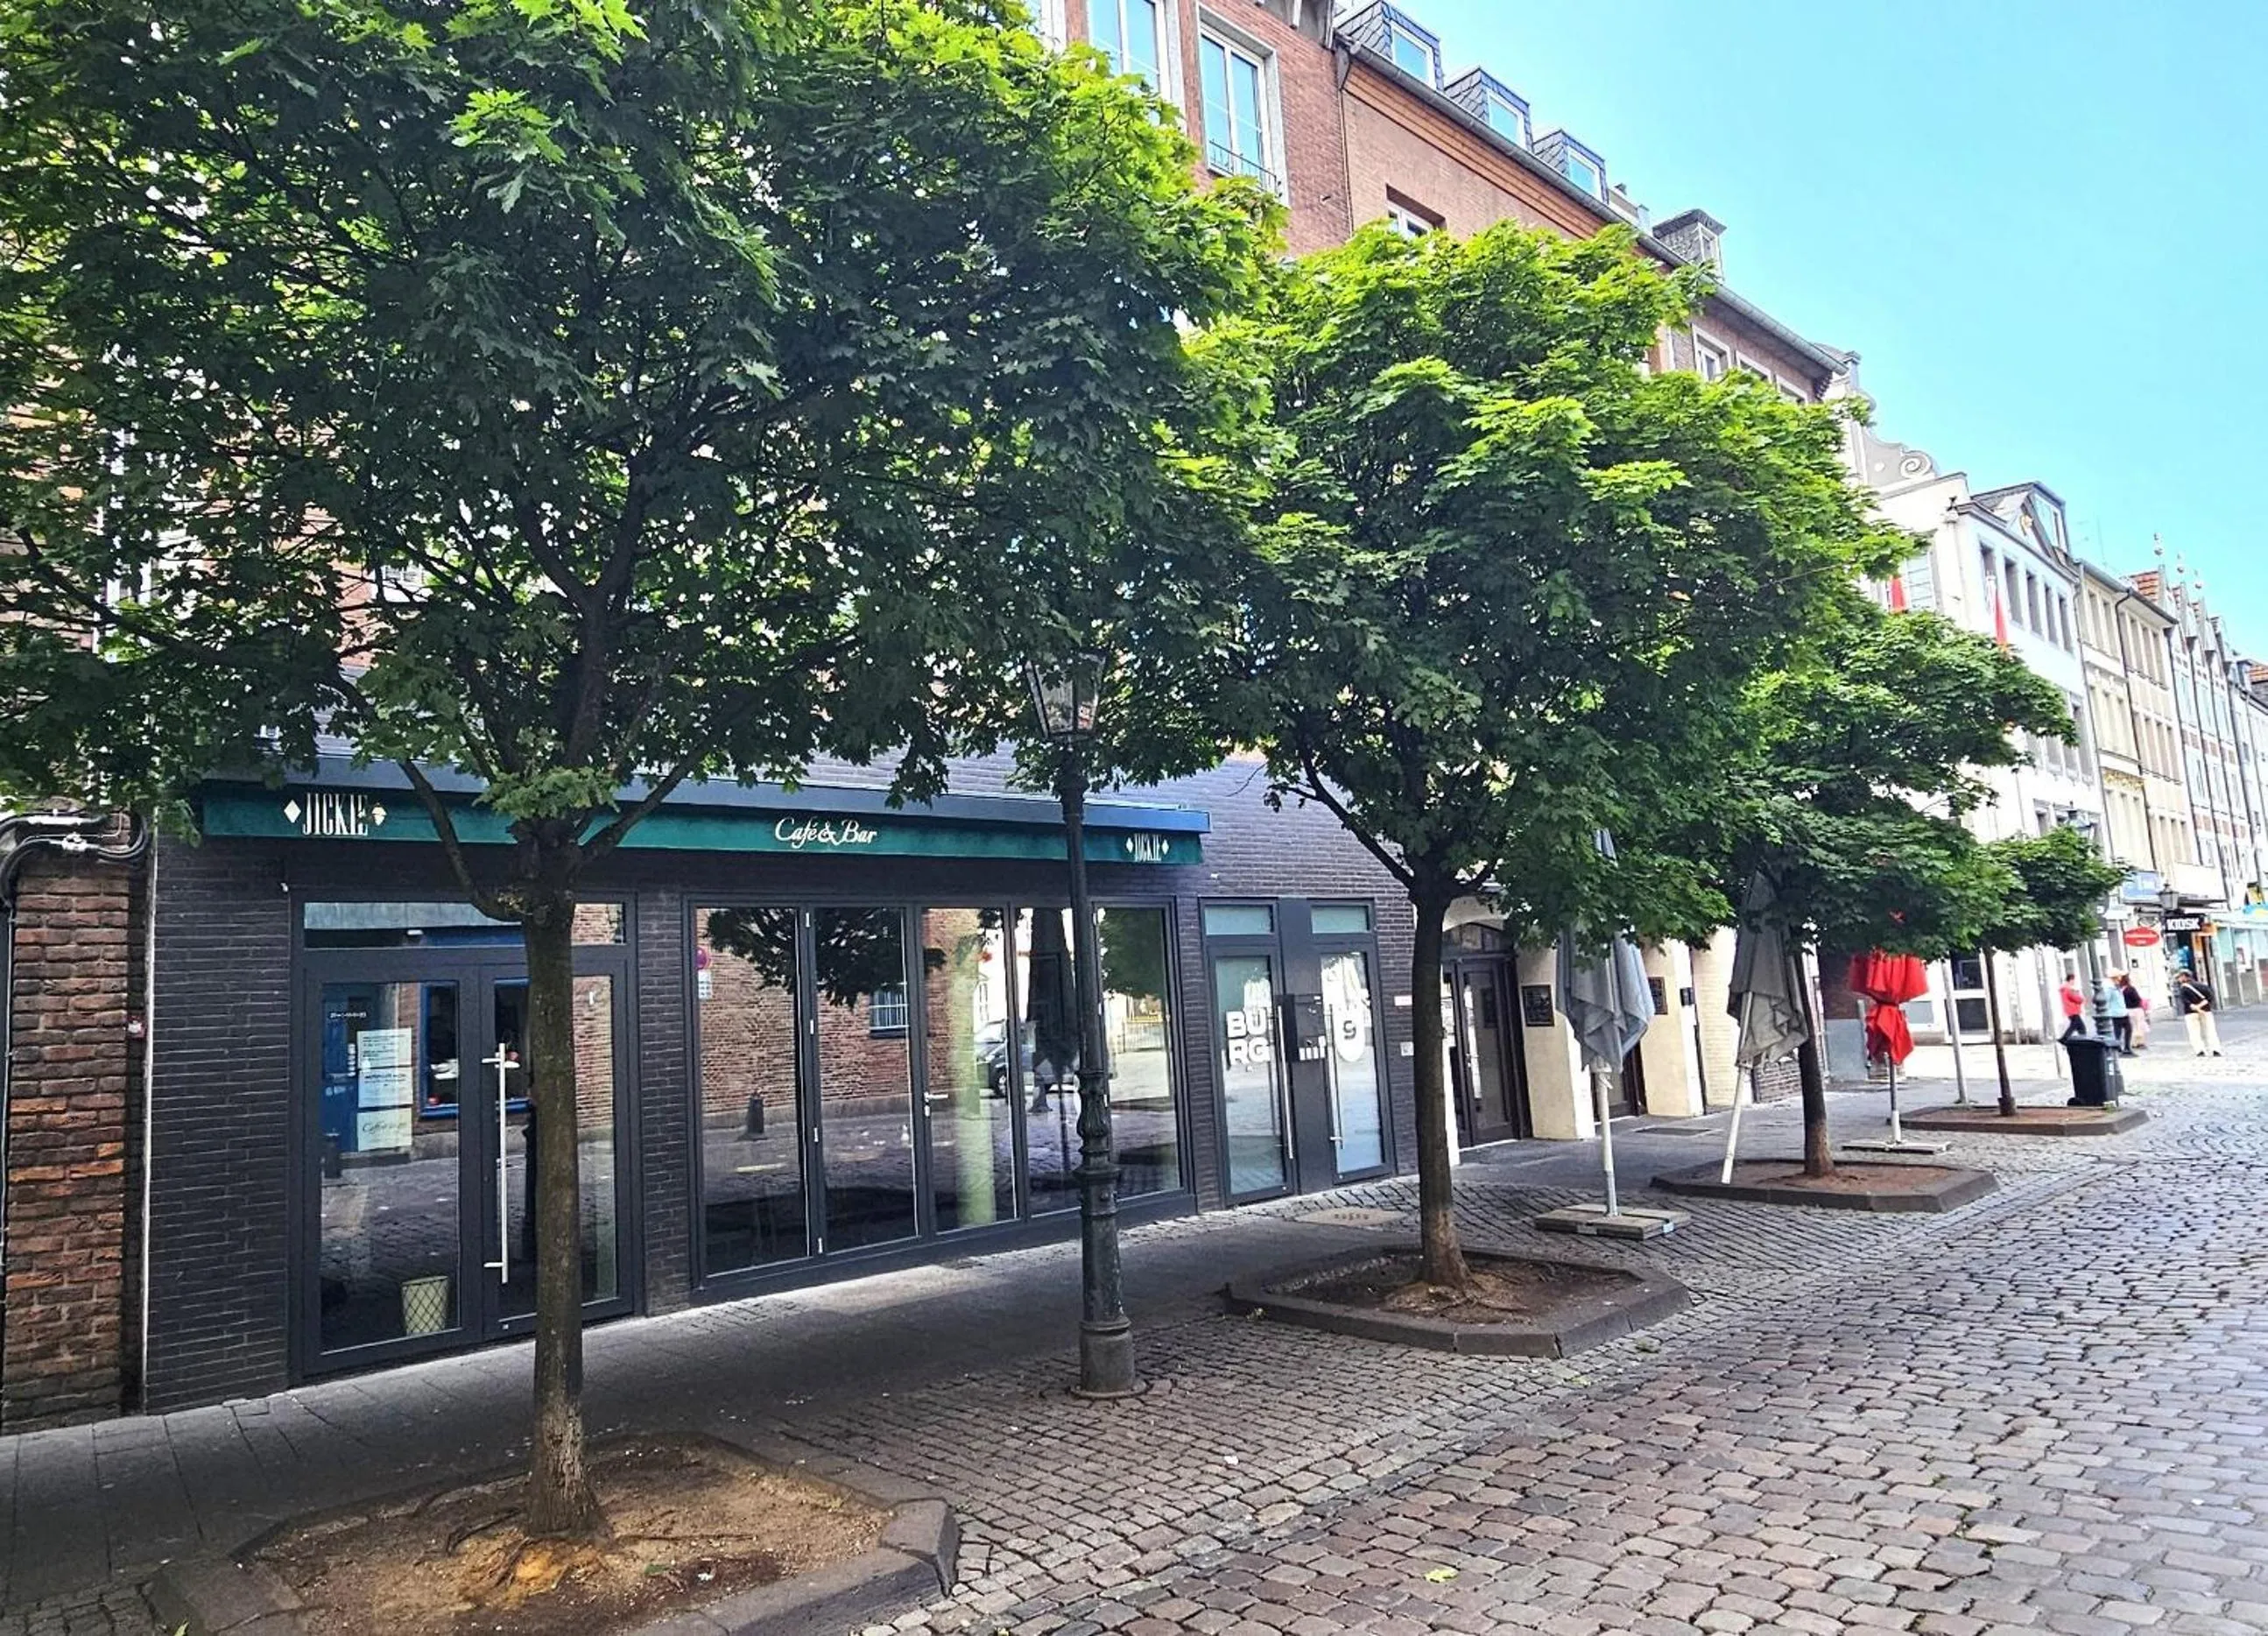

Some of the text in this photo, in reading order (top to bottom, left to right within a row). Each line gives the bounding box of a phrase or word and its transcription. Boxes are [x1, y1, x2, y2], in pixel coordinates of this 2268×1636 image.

[775, 815, 818, 849] Café
[842, 819, 877, 843] Bar
[2166, 918, 2201, 931] KIOSK
